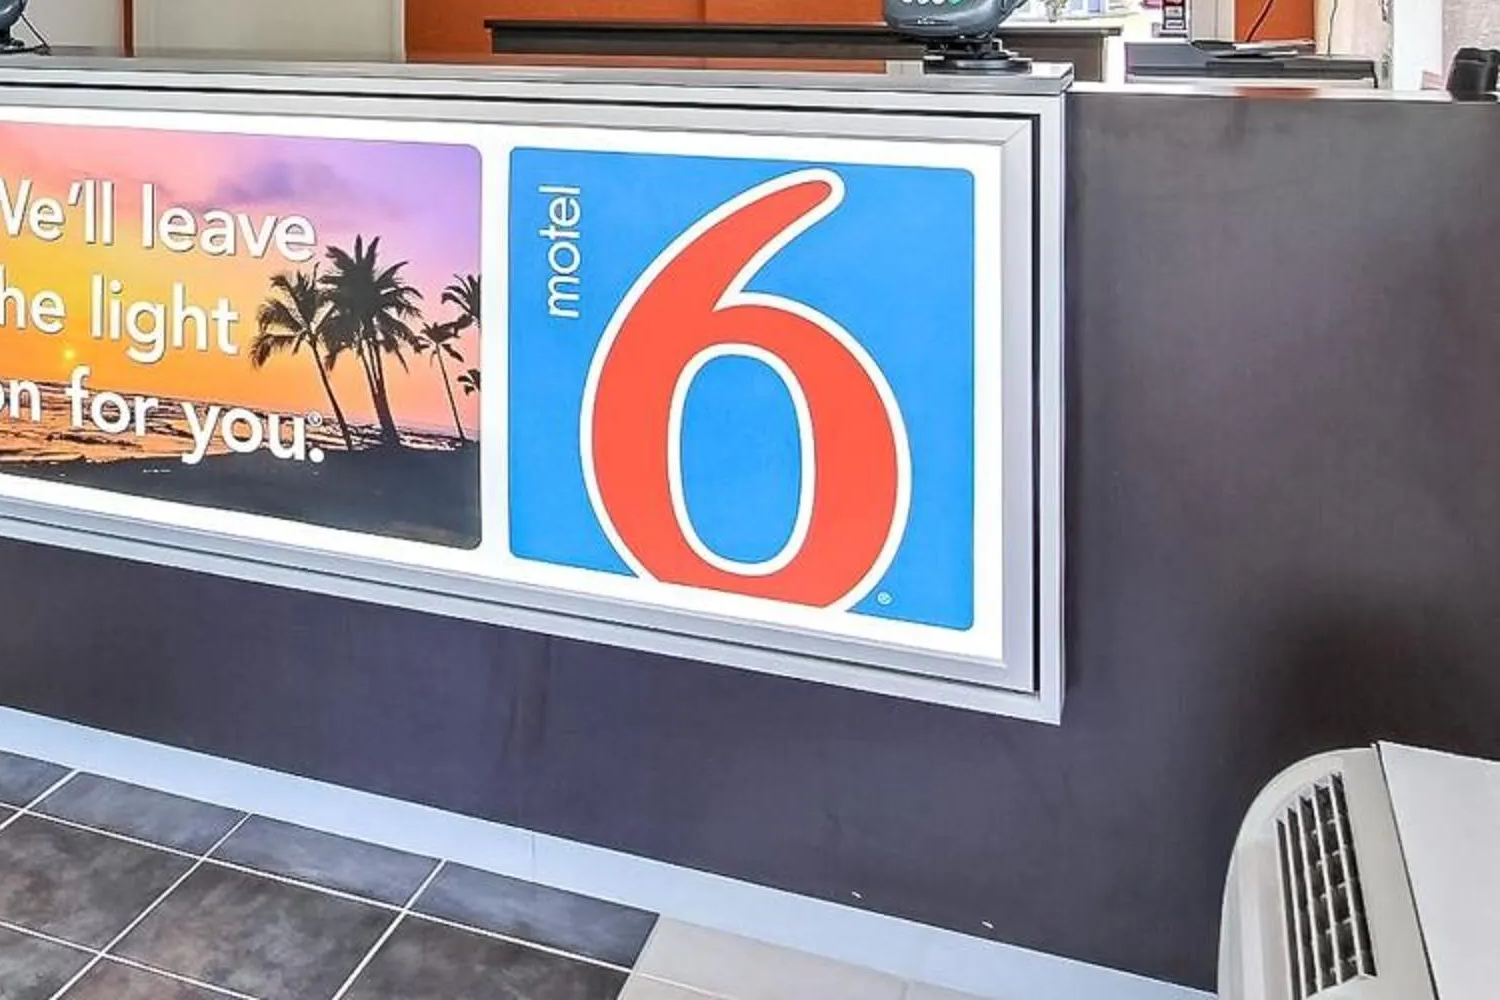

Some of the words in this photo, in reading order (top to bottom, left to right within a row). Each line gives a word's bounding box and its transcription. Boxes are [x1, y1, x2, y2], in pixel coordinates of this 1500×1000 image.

[141, 183, 318, 262] leave
[538, 185, 581, 320] motel
[91, 274, 240, 364] light
[65, 365, 159, 437] for
[579, 167, 913, 613] 6
